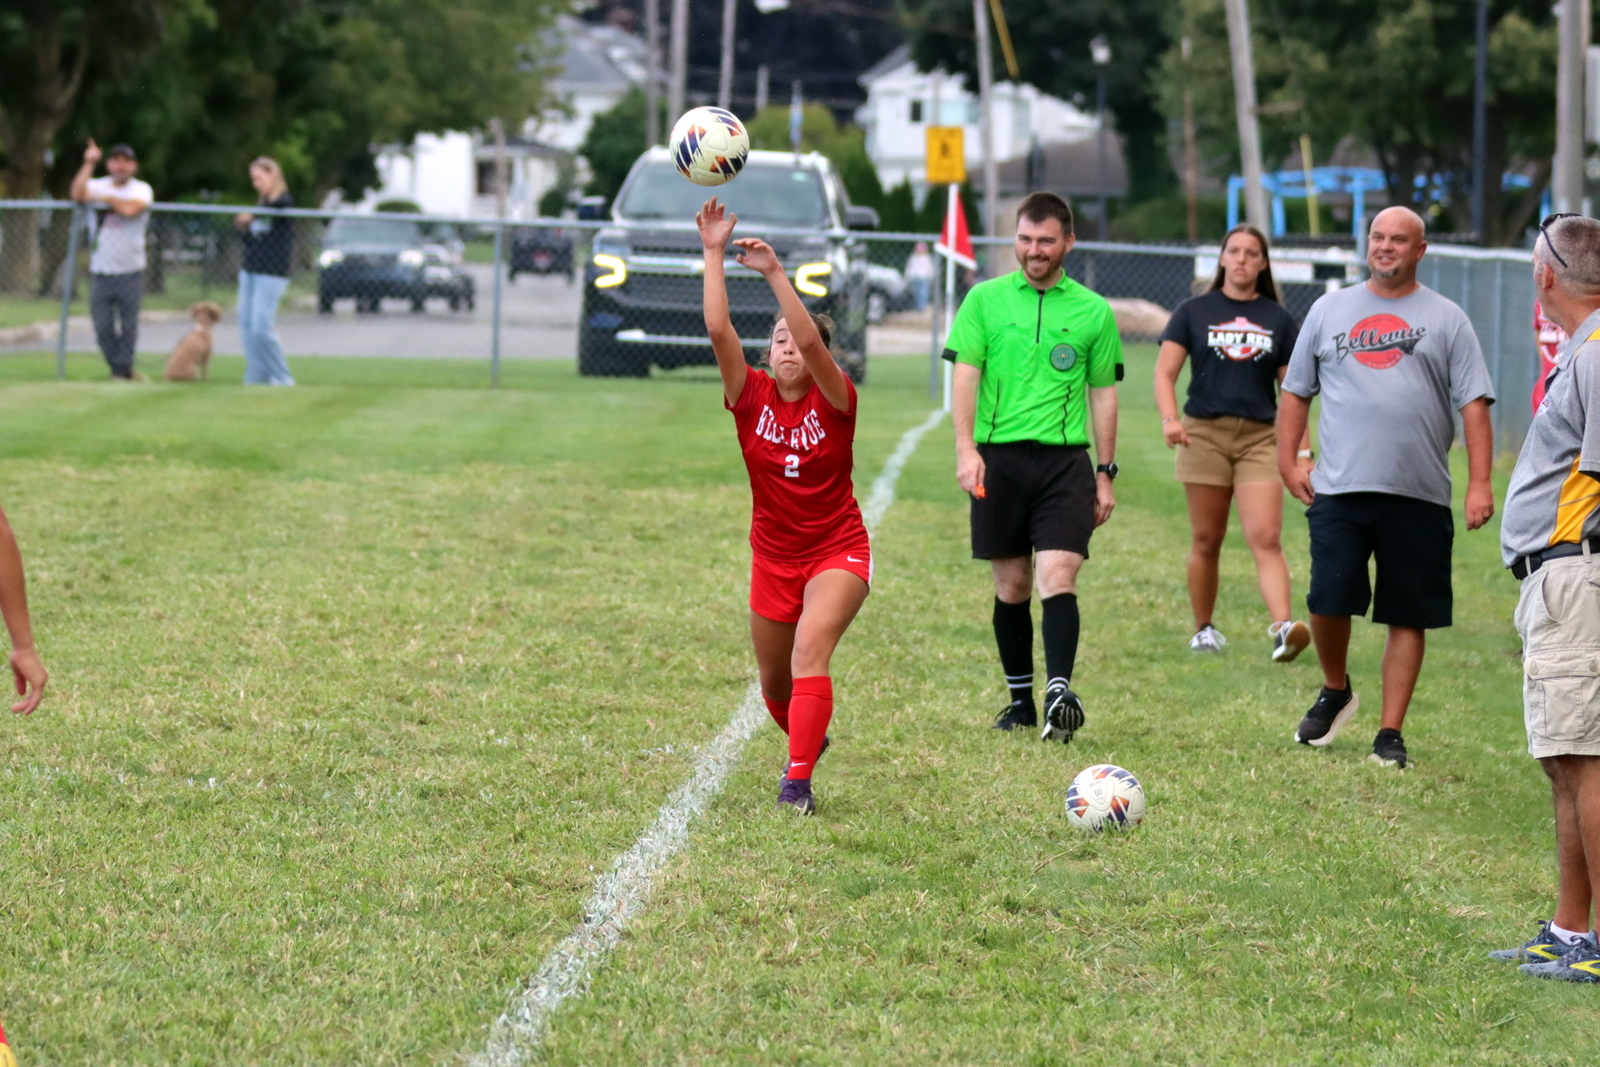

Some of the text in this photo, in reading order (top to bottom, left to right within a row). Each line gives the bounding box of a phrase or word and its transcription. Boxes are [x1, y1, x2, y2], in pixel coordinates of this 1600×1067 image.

[1208, 331, 1273, 350] LADY RED
[1332, 326, 1427, 365] Bellevue
[784, 454, 800, 477] 2
